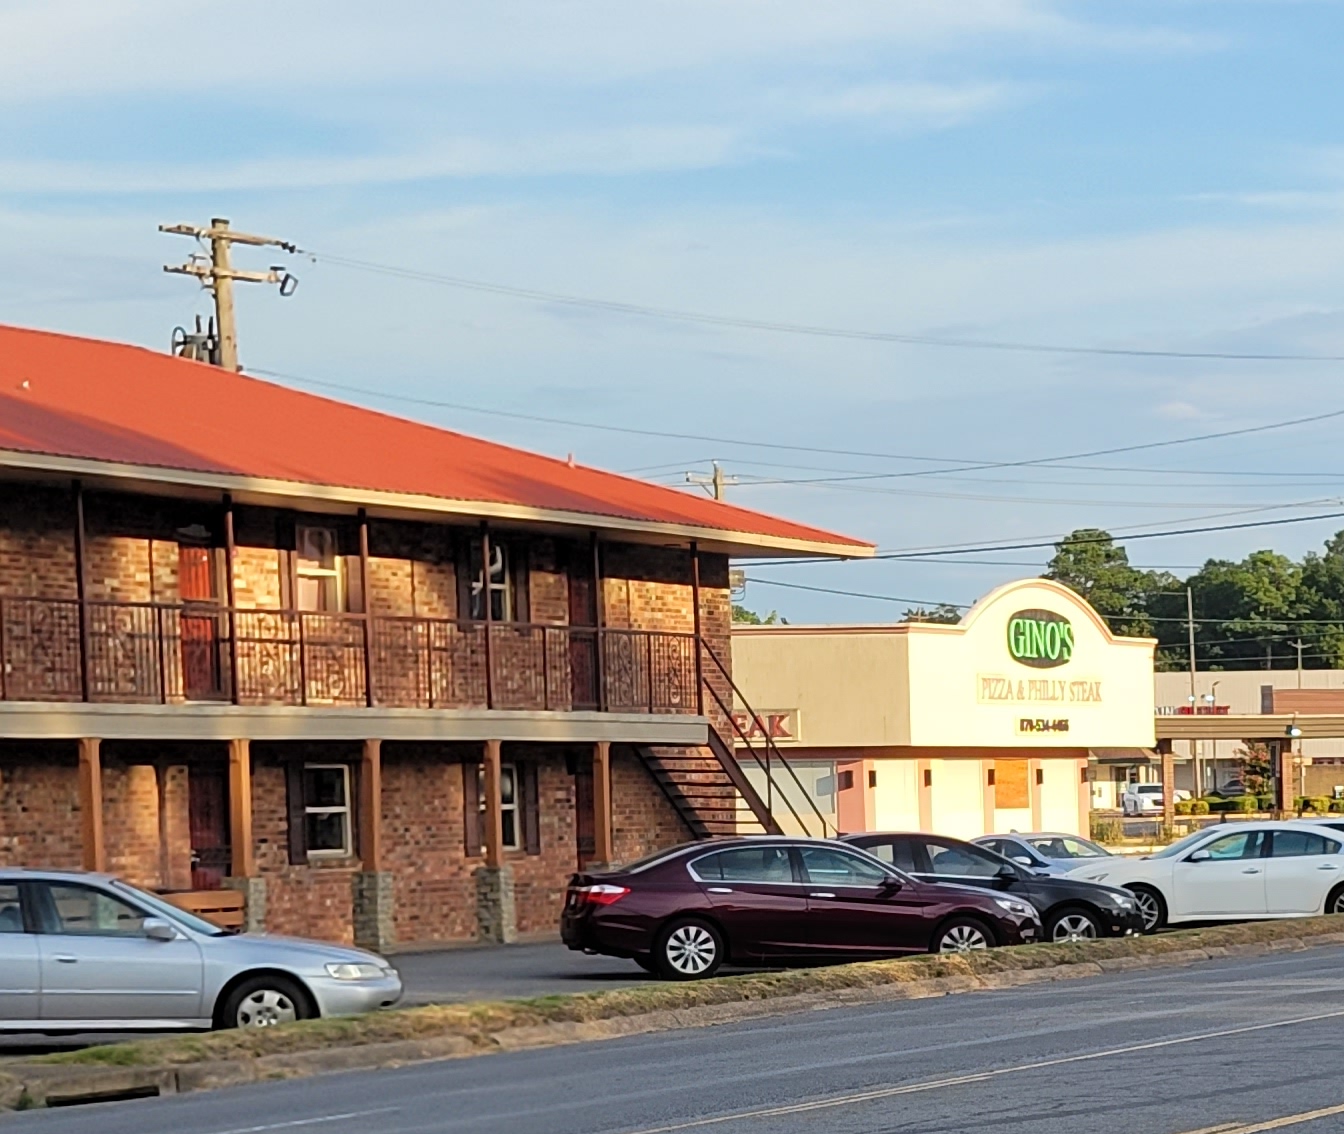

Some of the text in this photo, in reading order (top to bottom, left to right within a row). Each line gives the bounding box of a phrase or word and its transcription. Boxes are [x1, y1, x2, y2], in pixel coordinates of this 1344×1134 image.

[1009, 618, 1074, 660] GINO'S
[981, 677, 1102, 702] PIZZA & PHILLY STEAK
[732, 715, 793, 738] EAK
